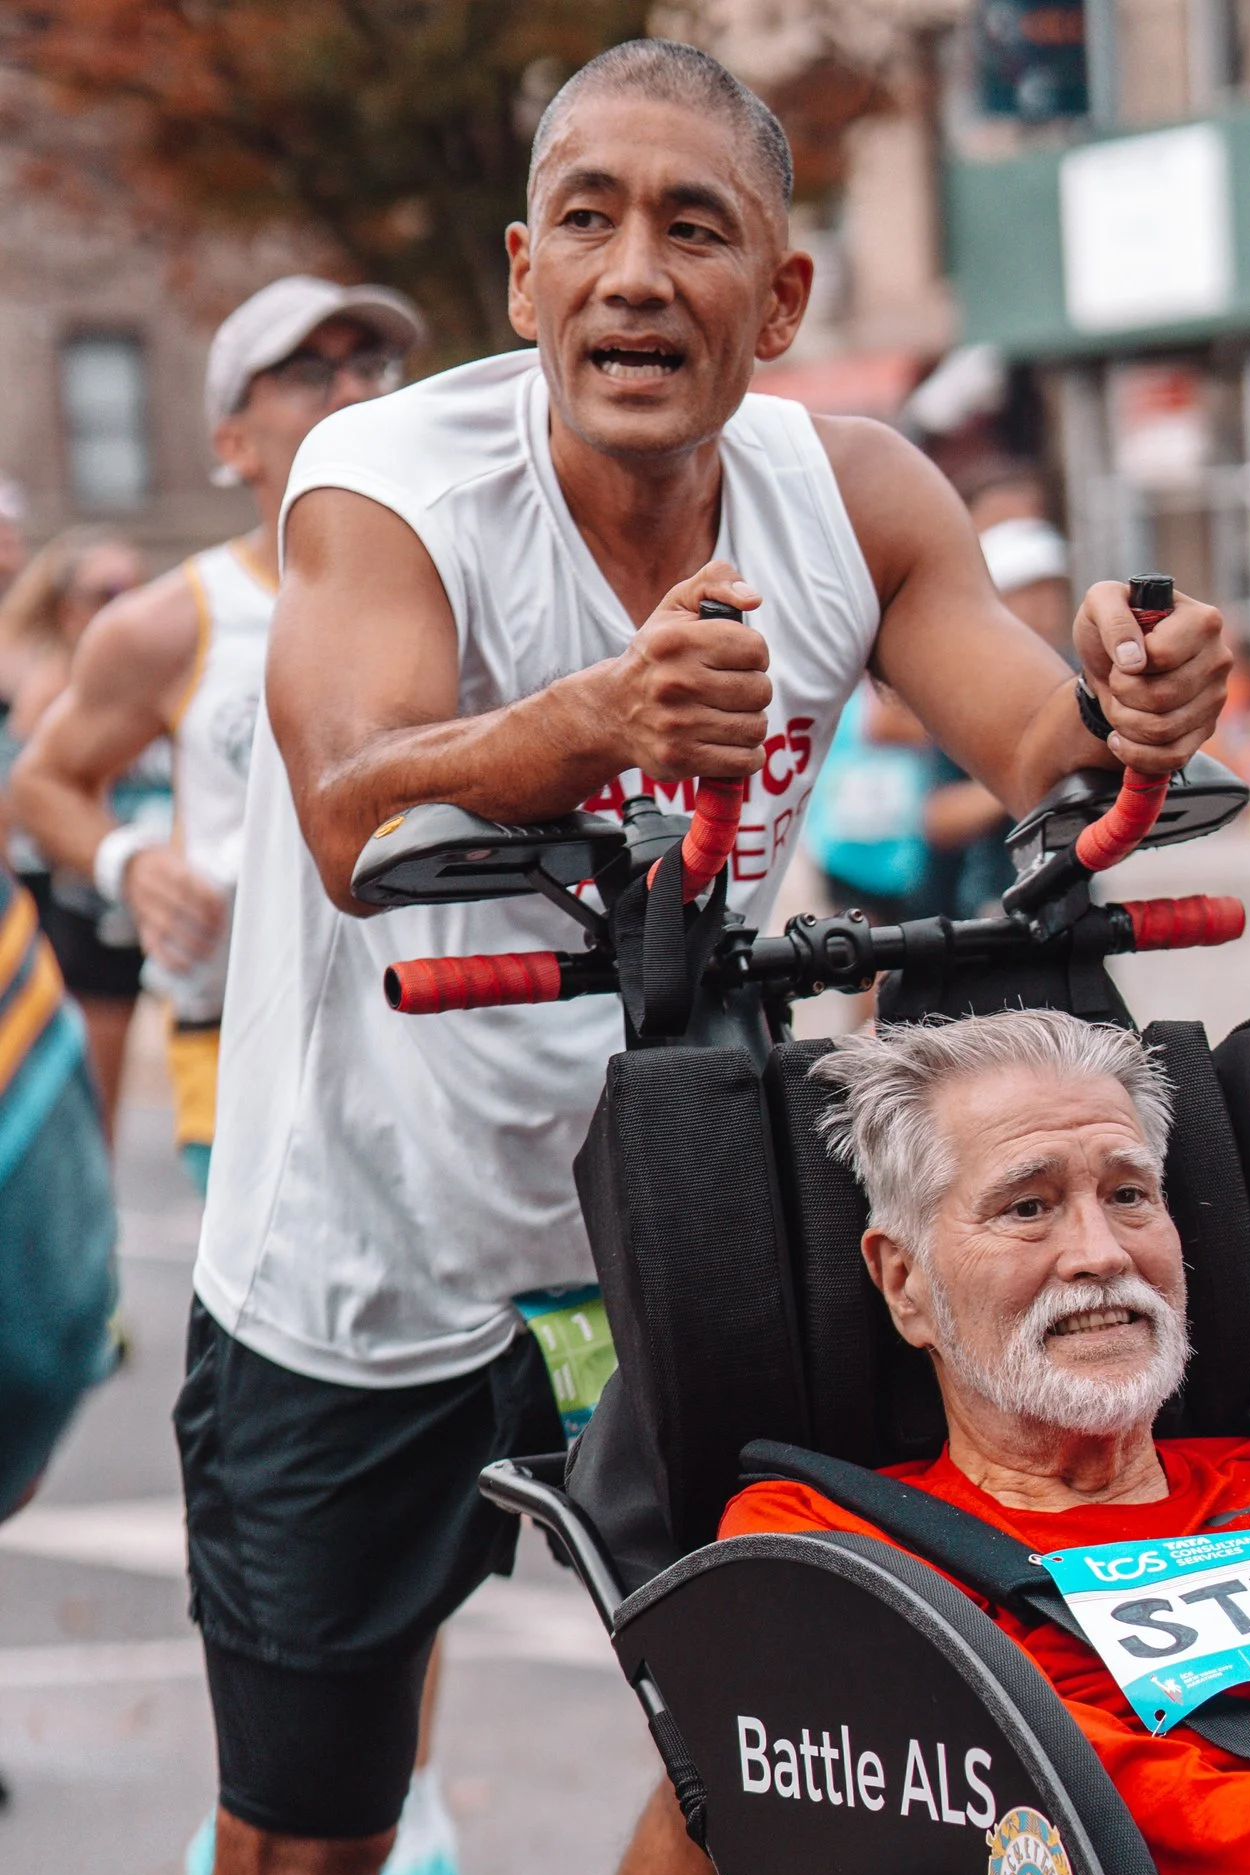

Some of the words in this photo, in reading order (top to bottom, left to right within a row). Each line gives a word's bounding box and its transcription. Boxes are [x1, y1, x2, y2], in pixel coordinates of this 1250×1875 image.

[1163, 1537, 1211, 1551] TATA
[1083, 1551, 1168, 1582] tcs
[1175, 1547, 1245, 1567] SERVICES
[736, 1714, 886, 1812] Battle
[899, 1738, 997, 1830] ALS
